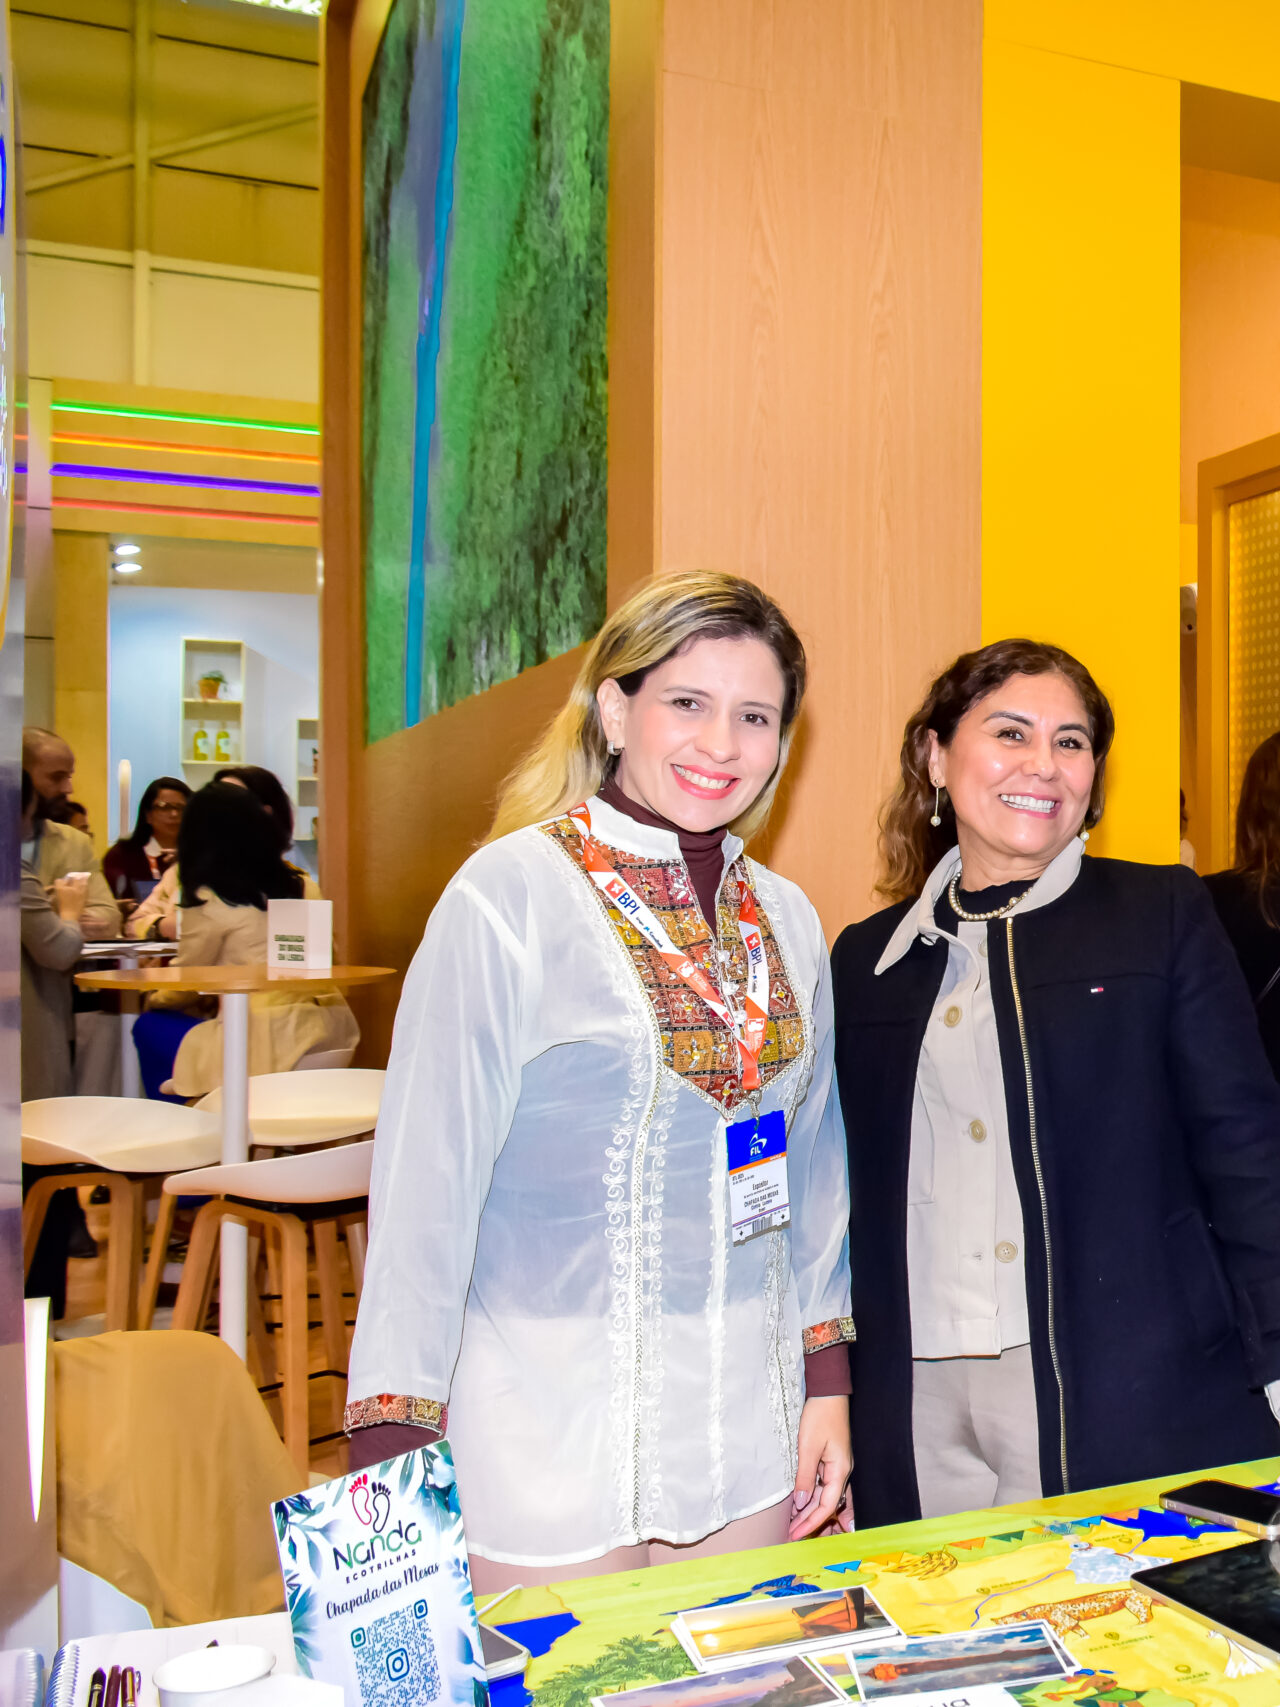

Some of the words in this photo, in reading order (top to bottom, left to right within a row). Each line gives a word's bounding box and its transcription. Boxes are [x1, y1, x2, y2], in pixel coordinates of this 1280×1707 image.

[616, 890, 640, 916] BPI
[750, 946, 762, 971] BPI
[750, 1146, 761, 1156] FIL
[333, 1520, 422, 1571] Nanda
[346, 1549, 416, 1584] ECOTRILHAS
[326, 1588, 382, 1619] Chapada
[382, 1577, 402, 1596] das
[404, 1562, 440, 1586] Mesas
